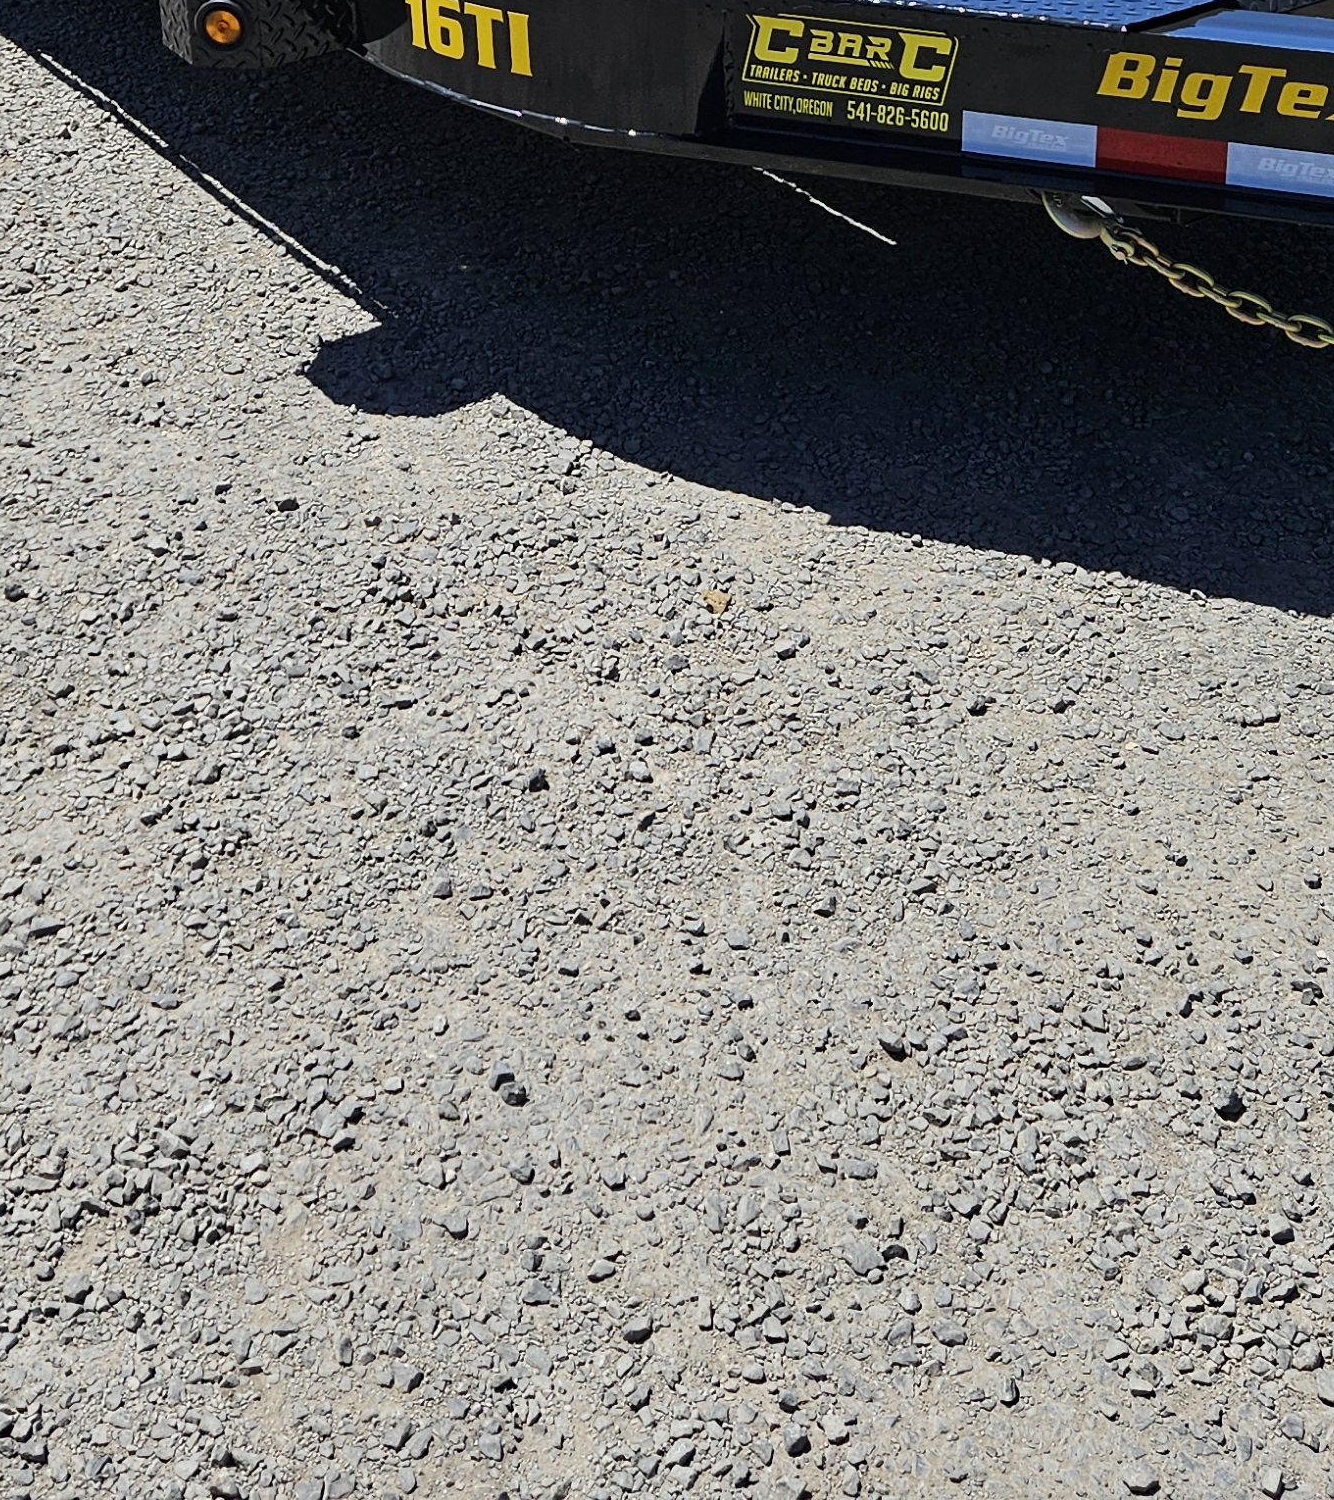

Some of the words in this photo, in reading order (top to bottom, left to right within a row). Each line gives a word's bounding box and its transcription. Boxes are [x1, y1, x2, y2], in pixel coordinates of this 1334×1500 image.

[752, 15, 805, 64] C
[810, 28, 892, 61] BAR
[898, 32, 953, 82] C
[749, 64, 801, 83] TRAILERS
[811, 72, 847, 89] TRUCK
[849, 74, 879, 93] BEDS
[889, 81, 910, 96] BIG
[913, 84, 941, 101] RIGS
[743, 90, 773, 110] WHITE
[847, 100, 949, 132] 541-826-5600
[991, 125, 1069, 146] BigTex
